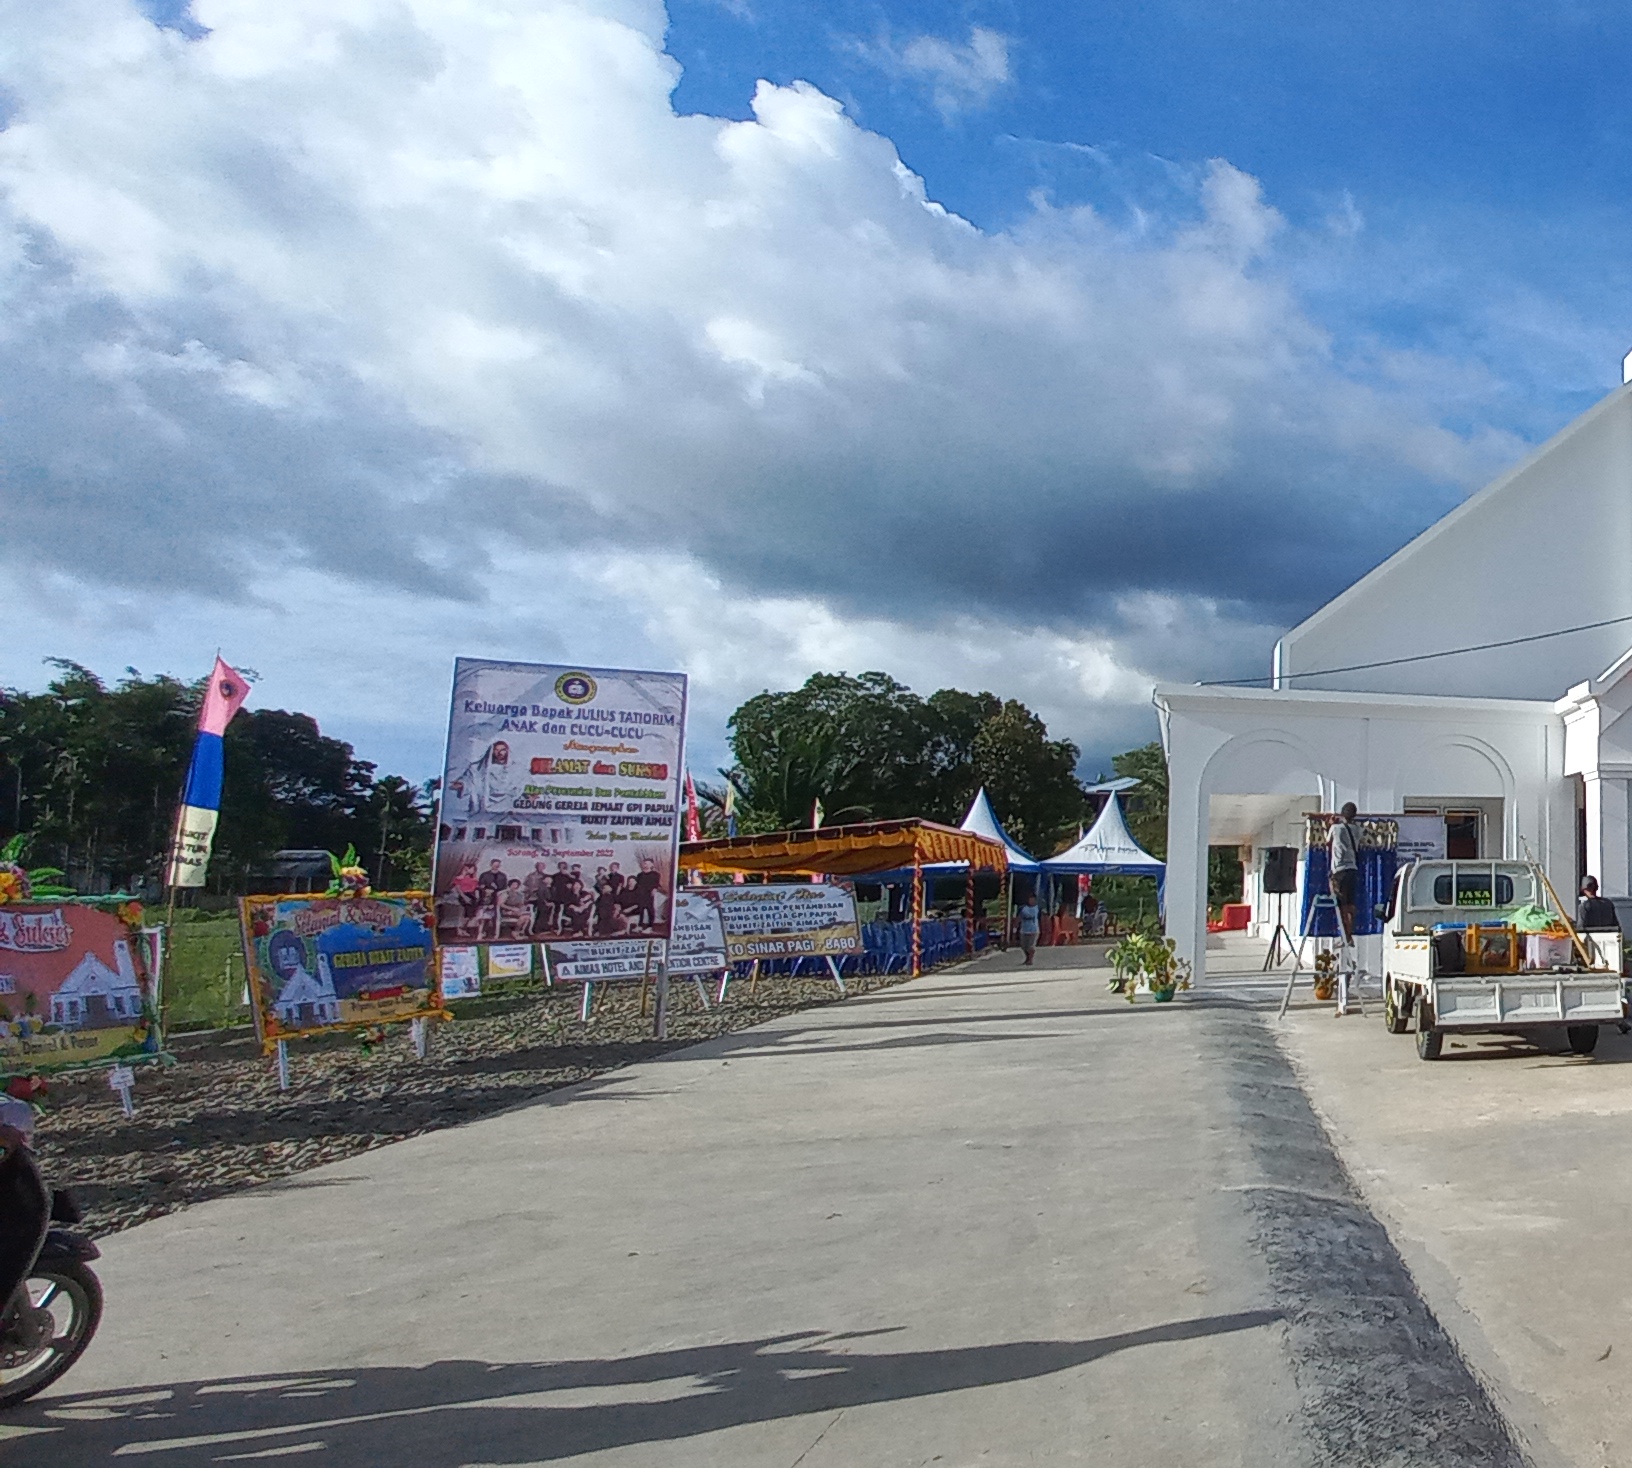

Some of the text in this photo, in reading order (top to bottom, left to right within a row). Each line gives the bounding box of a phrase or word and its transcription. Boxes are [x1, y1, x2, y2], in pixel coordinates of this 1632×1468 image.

[463, 700, 528, 717] Keluarga
[531, 704, 574, 720] Bapak
[575, 708, 616, 722] JULIUS
[500, 719, 645, 740] ANAK dan CUCU-CUCU
[513, 800, 675, 813] GEDUNG GEREJA JEMAAT GPI PAPUA
[581, 815, 673, 827] BUKIT ZAITUN AIMAS
[551, 849, 594, 859] September
[1458, 890, 1491, 899] JASA
[809, 910, 839, 918] PAPUA
[795, 919, 824, 927] AIMAS
[625, 945, 660, 954] ZAITN
[747, 940, 786, 955] SINAR
[787, 939, 815, 952] PAGI
[824, 936, 856, 950] BABO
[601, 961, 628, 973] HOTEL
